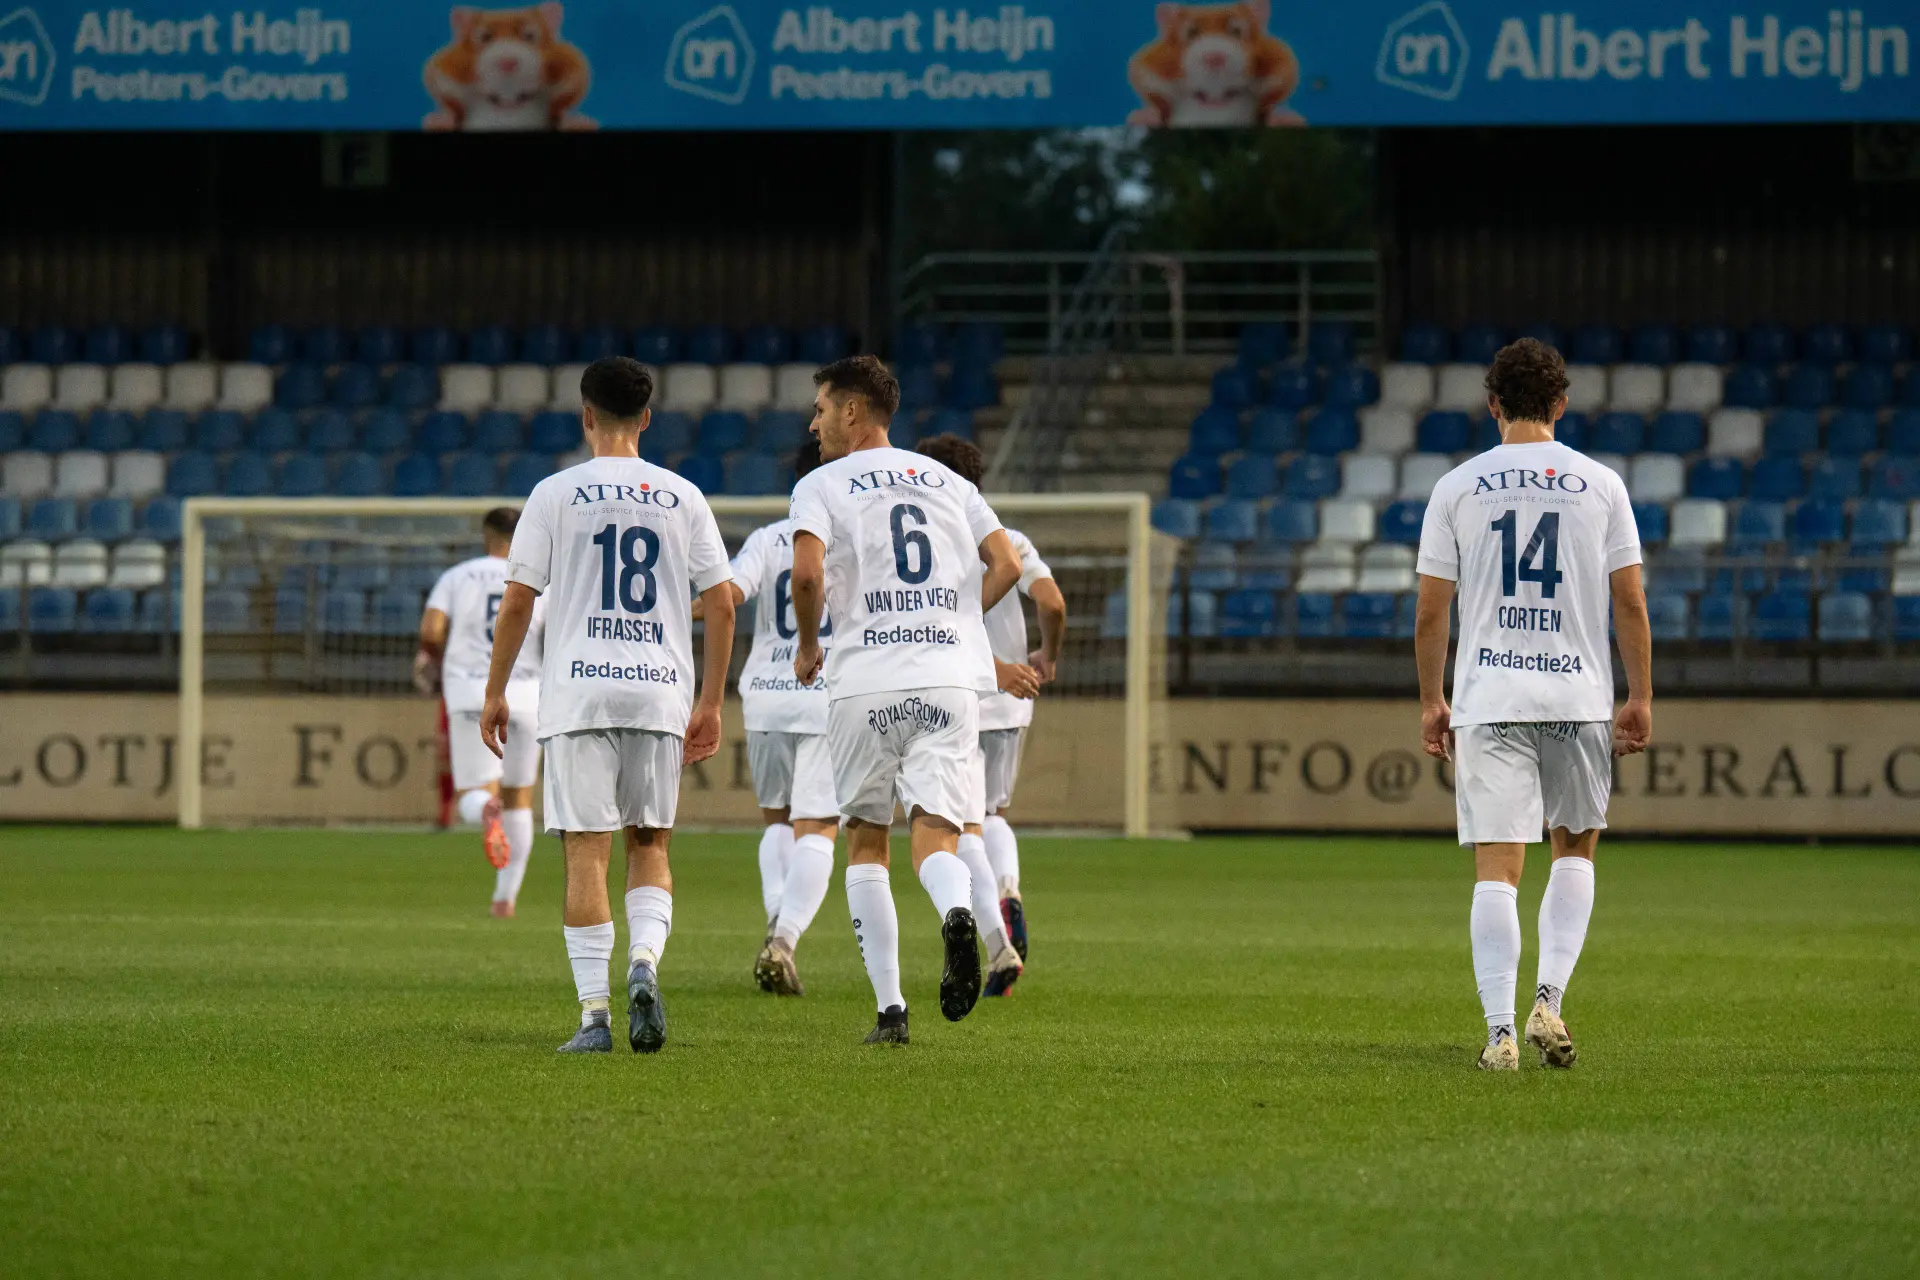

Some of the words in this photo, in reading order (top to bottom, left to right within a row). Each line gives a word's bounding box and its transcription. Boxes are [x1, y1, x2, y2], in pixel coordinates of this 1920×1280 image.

[73, 9, 221, 56] Albert
[230, 8, 351, 65] Heijn
[773, 8, 920, 54] Albert
[934, 8, 1055, 61] Heijn
[1488, 14, 1709, 81] Albert
[1729, 8, 1910, 92] Heijn
[577, 507, 632, 518] FULL-SERVICE
[1480, 496, 1537, 505] FULL-SERVICE
[1540, 496, 1581, 506] FLOORING
[889, 503, 932, 585] 6
[1491, 509, 1563, 599] 14
[593, 523, 660, 614] 18
[865, 591, 893, 614] VAN
[895, 590, 924, 612] DER
[926, 587, 959, 613] VEKEN
[587, 616, 664, 645] IFRASSEN
[1498, 605, 1562, 633] CORTEN
[863, 625, 961, 646] Redactie24
[571, 660, 678, 686] Redactie24
[1478, 648, 1582, 674] Redactie24
[1540, 729, 1566, 743] Cola
